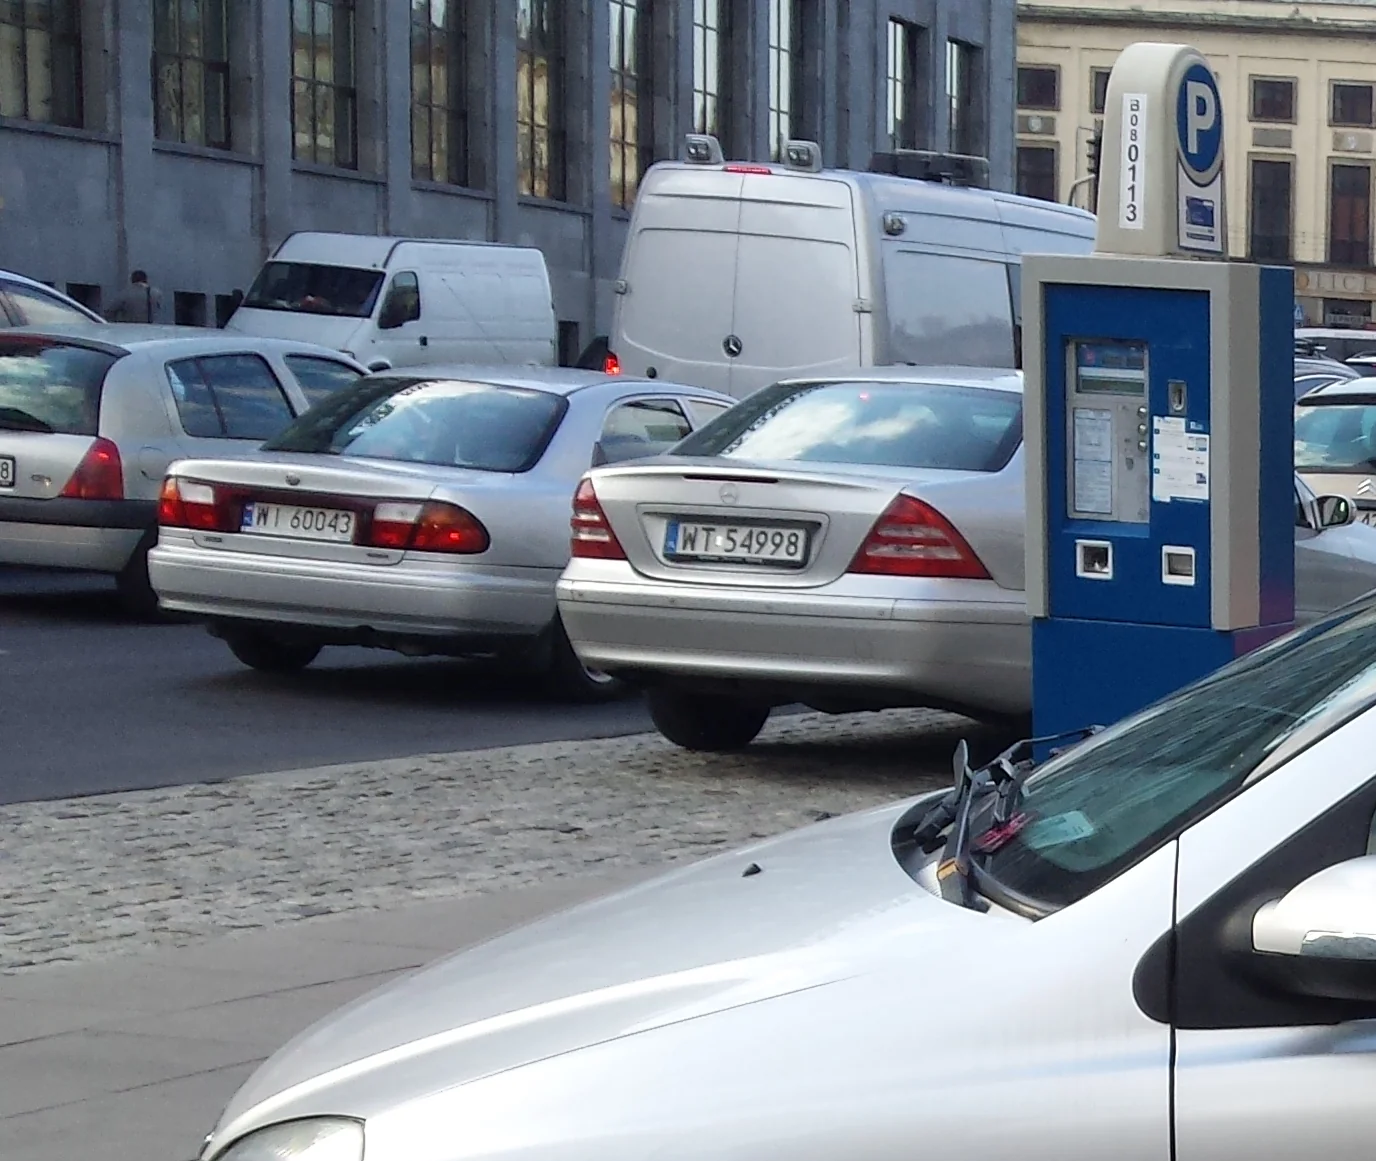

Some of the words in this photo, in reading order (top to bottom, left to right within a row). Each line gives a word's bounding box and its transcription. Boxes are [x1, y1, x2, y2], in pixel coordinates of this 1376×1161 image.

[1187, 81, 1216, 154] P
[290, 510, 351, 534] 60043
[682, 526, 715, 551] WT
[724, 528, 799, 557] 54998
